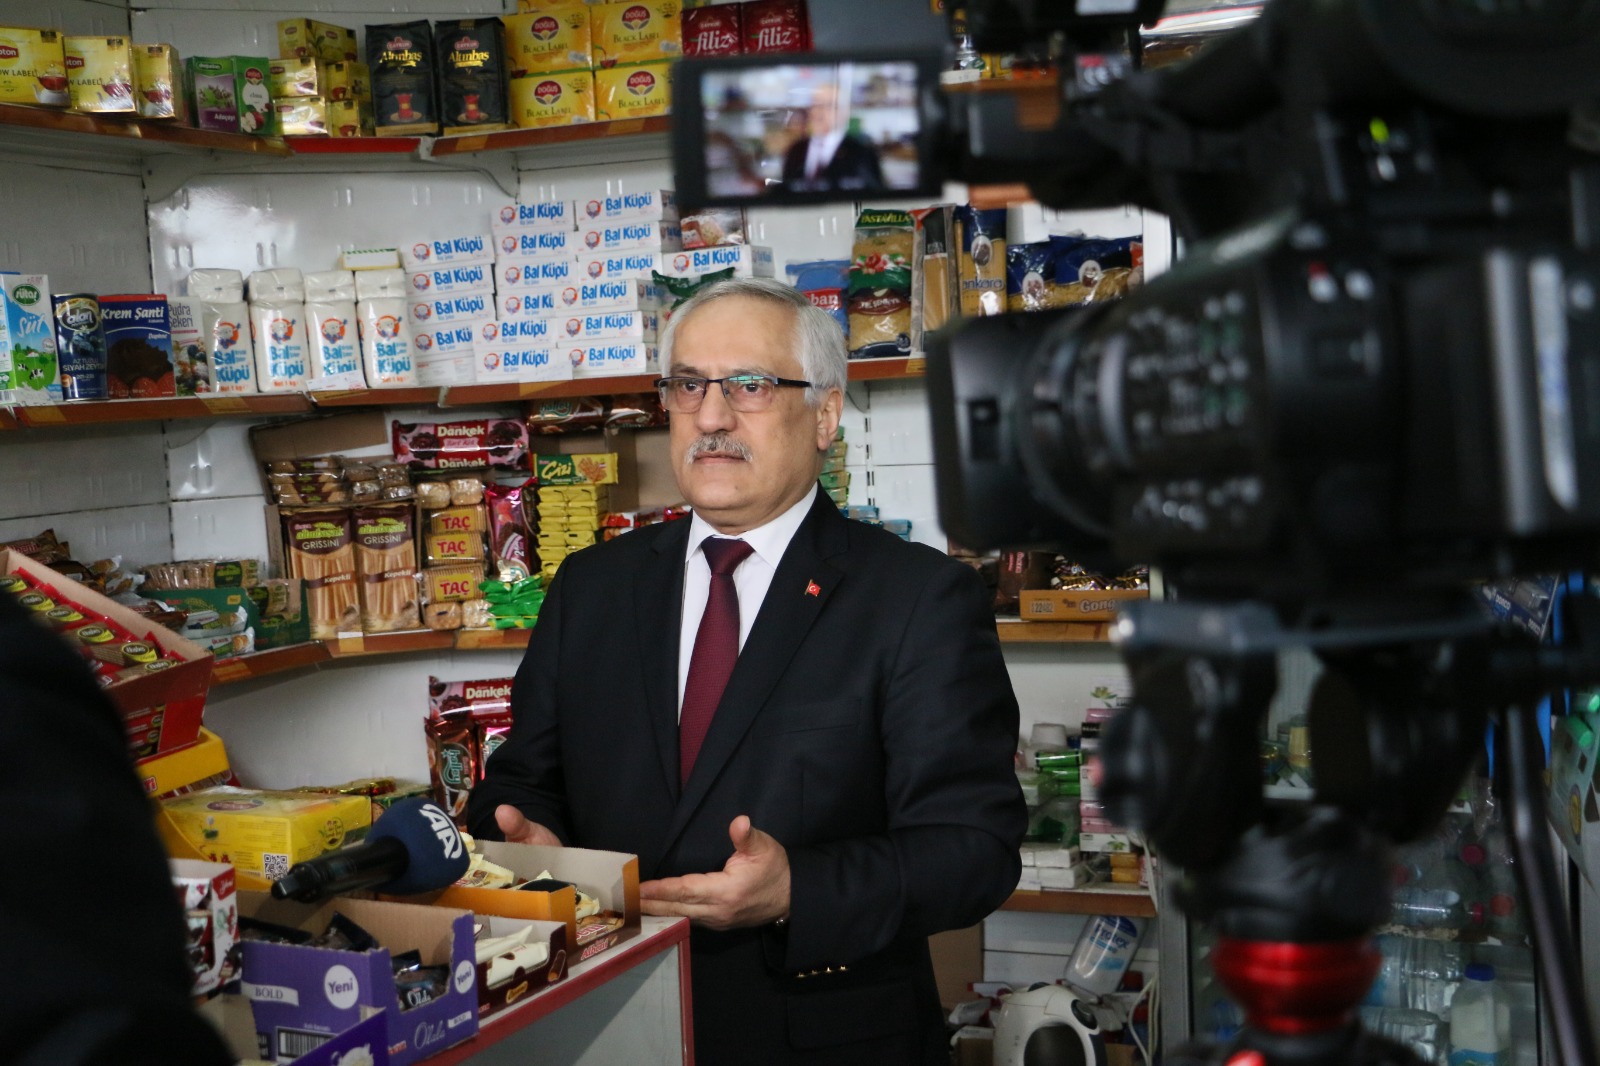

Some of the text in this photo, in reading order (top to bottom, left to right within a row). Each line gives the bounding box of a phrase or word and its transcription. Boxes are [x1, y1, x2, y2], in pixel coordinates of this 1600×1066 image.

[695, 30, 731, 56] filiz
[757, 26, 792, 52] filiz
[606, 192, 652, 211] Bal Küpü
[520, 202, 564, 220] Bal Küpü
[521, 232, 565, 250] Bal Küpü
[605, 224, 651, 242] Bal Küpü
[434, 236, 483, 255] Bal Küpü
[608, 254, 652, 272] Bal Küpü
[694, 252, 710, 266] Bal
[712, 247, 740, 265] Küpü
[434, 266, 483, 285] Bal Küpü
[524, 262, 568, 280] Bal Küpü
[582, 284, 597, 300] Bal
[600, 281, 626, 300] Küpü
[435, 296, 484, 315] Bal Küpü
[524, 295, 540, 310] Bal
[101, 306, 165, 320] Krem Şanti
[586, 316, 602, 330] Bal
[605, 313, 632, 330] Küpü
[16, 312, 46, 338] Süt
[502, 320, 546, 338] Bal Küpü
[436, 331, 454, 346] Bal
[214, 350, 236, 365] Bal
[270, 345, 290, 360] Bal
[322, 345, 342, 360] Bal
[376, 342, 397, 357] Bal
[589, 348, 606, 361] Bal
[608, 345, 636, 362] Küpü
[377, 357, 411, 374] Küpü
[504, 350, 548, 368] Bal Küpü
[216, 365, 250, 384] Küpü
[271, 360, 304, 378] Küpü
[438, 424, 485, 438] Dankek
[438, 458, 486, 468] Dankek
[541, 460, 572, 480] Çizi
[441, 516, 470, 530] TAÇ
[436, 540, 467, 554] TAÇ
[324, 574, 351, 584] Kepekli
[384, 570, 411, 579] Kepekli
[440, 580, 470, 595] TAÇ
[466, 686, 511, 700] Dankek
[254, 987, 284, 1000] BOLD
[328, 978, 354, 994] Yeni
